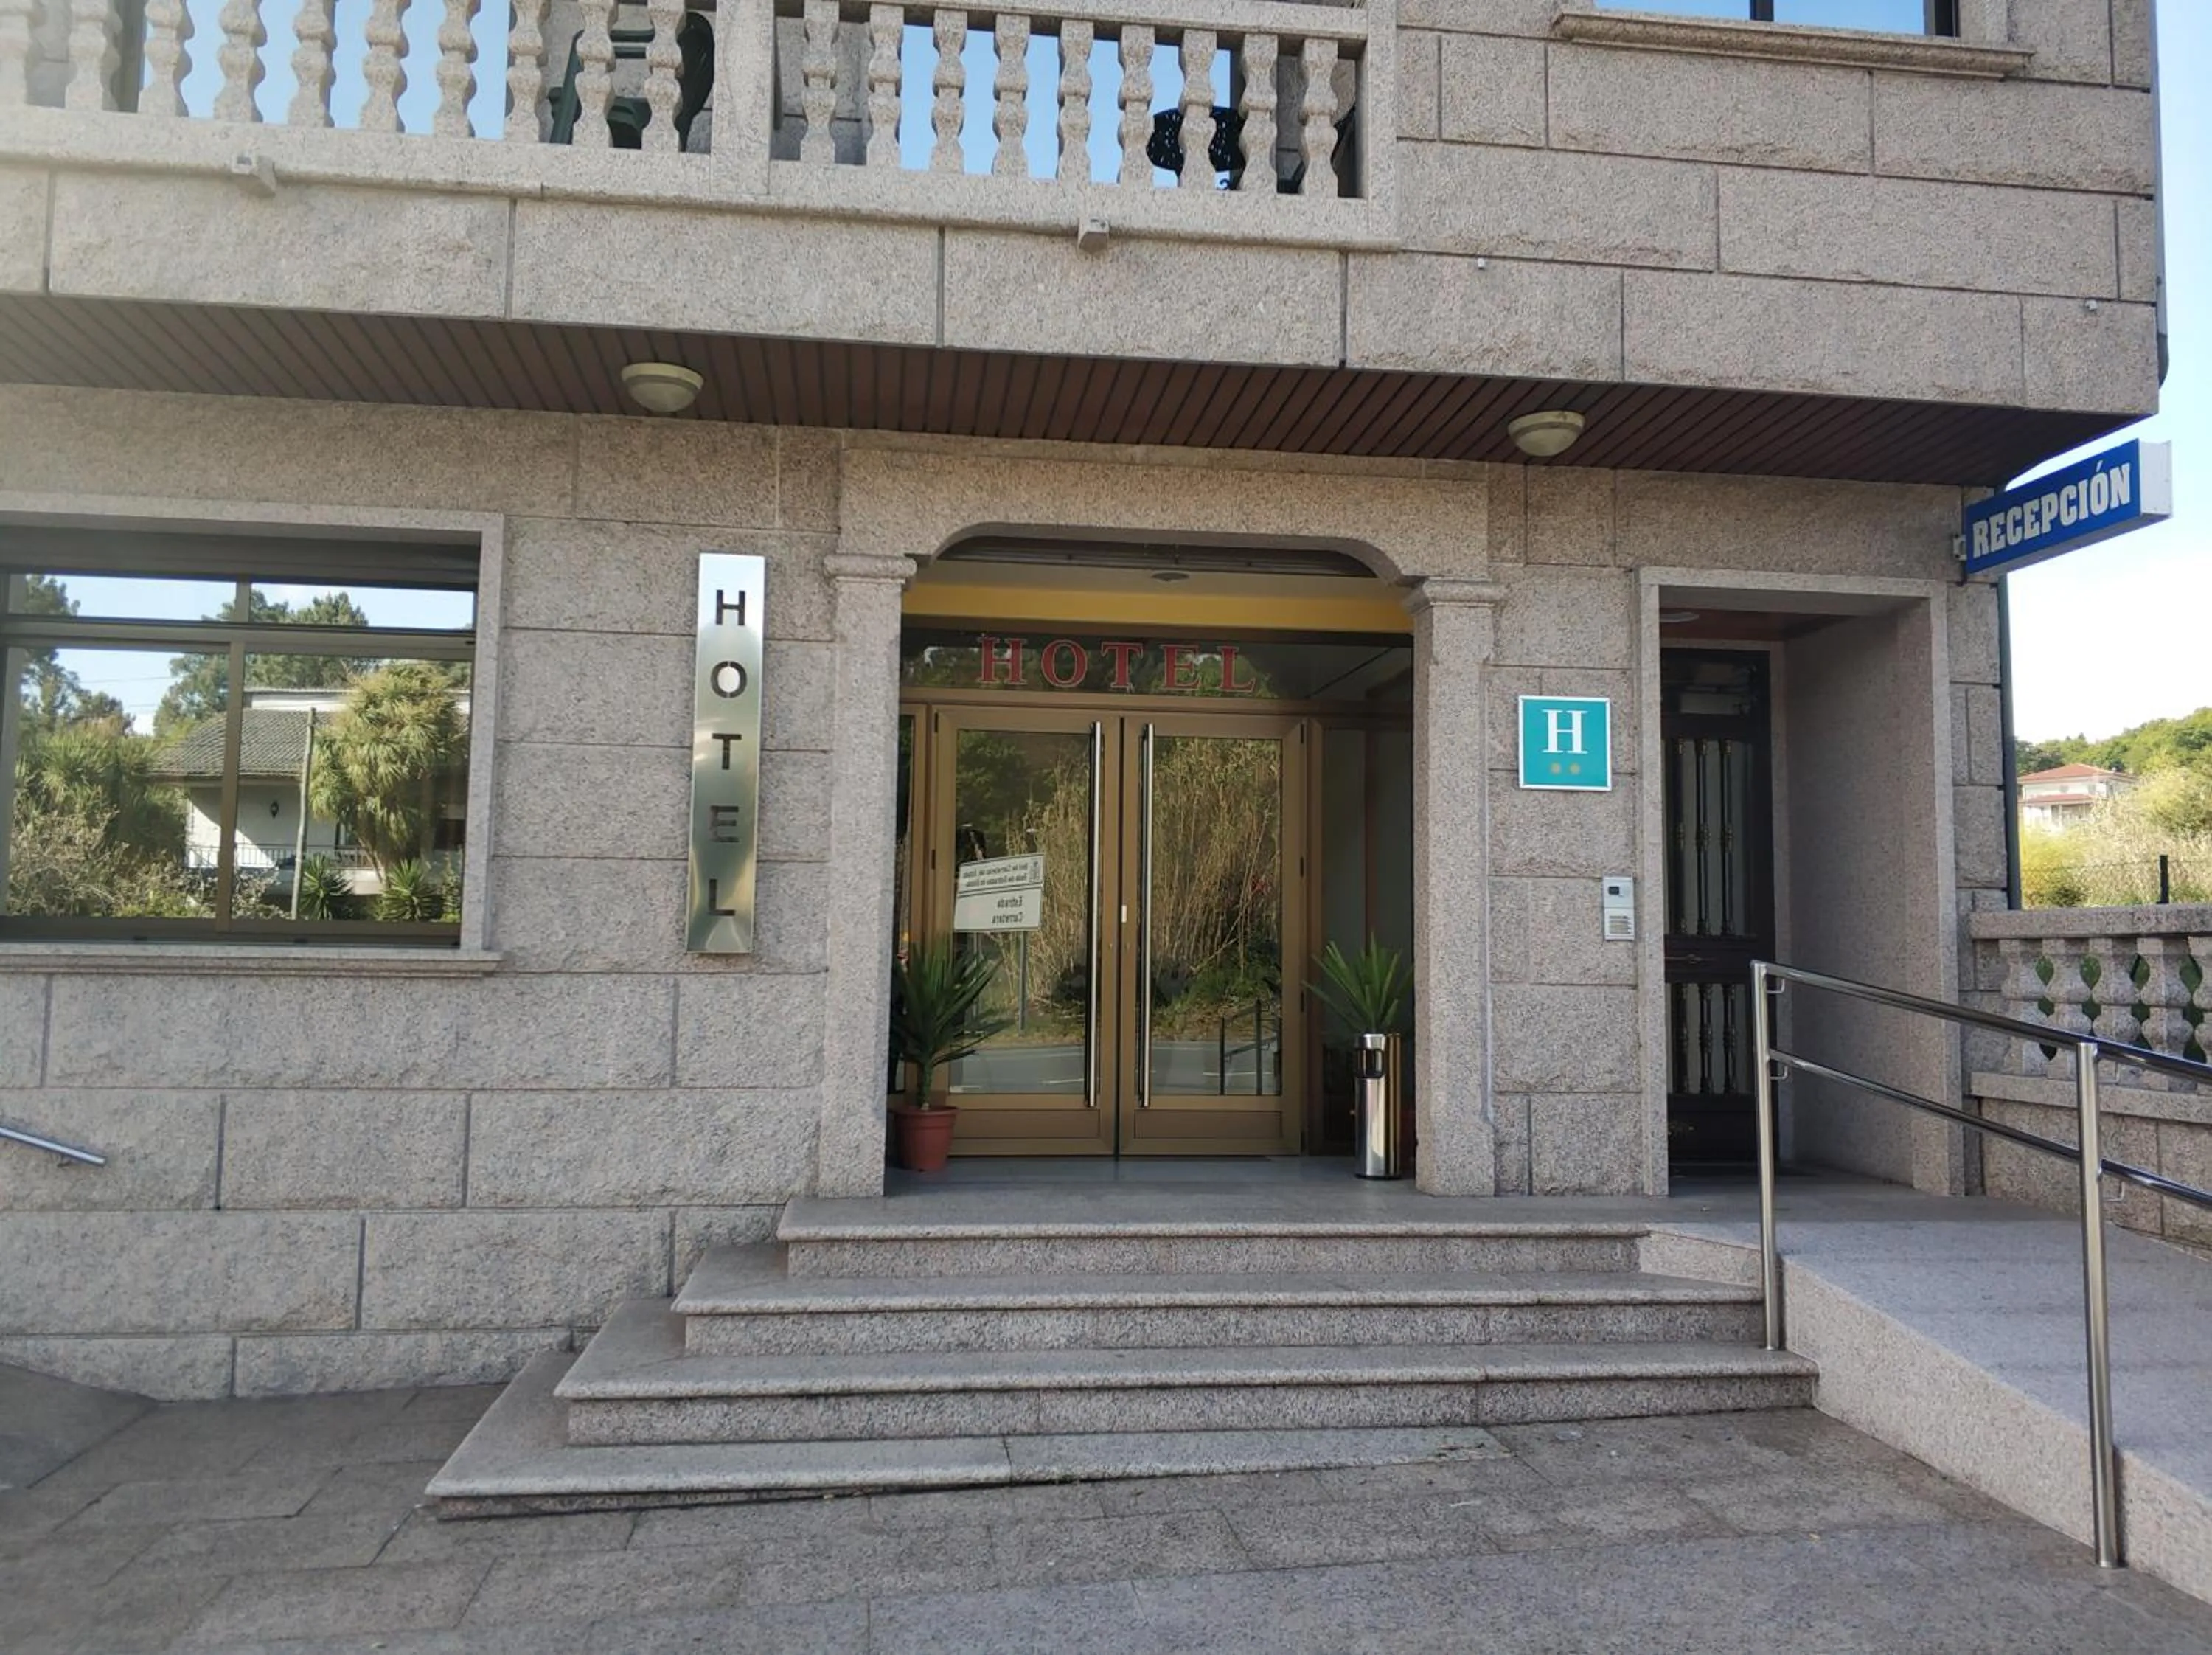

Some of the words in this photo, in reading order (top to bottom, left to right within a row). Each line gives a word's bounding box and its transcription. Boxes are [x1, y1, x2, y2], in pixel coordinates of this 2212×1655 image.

[1972, 460, 2131, 558] RECEPCIÓN
[978, 635, 1256, 693] HOTEL
[709, 589, 748, 917] HOTEL
[1542, 709, 1589, 754] H
